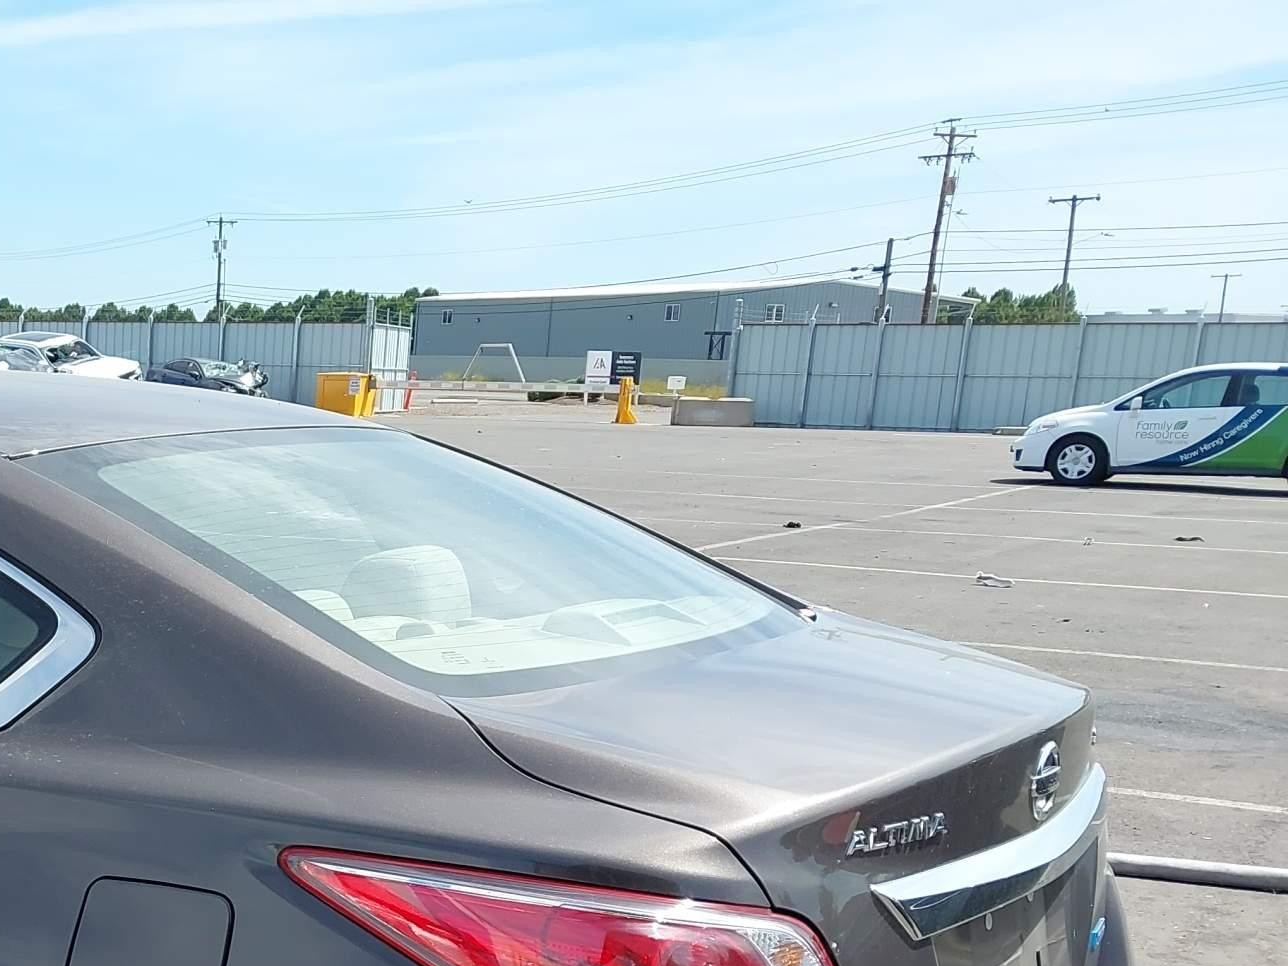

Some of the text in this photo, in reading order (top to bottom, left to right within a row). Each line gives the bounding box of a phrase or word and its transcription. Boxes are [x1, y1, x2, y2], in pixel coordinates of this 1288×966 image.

[1135, 431, 1190, 440] resource
[1179, 408, 1264, 461] Now Hiring Caregivers
[845, 812, 948, 856] ALTIMA
